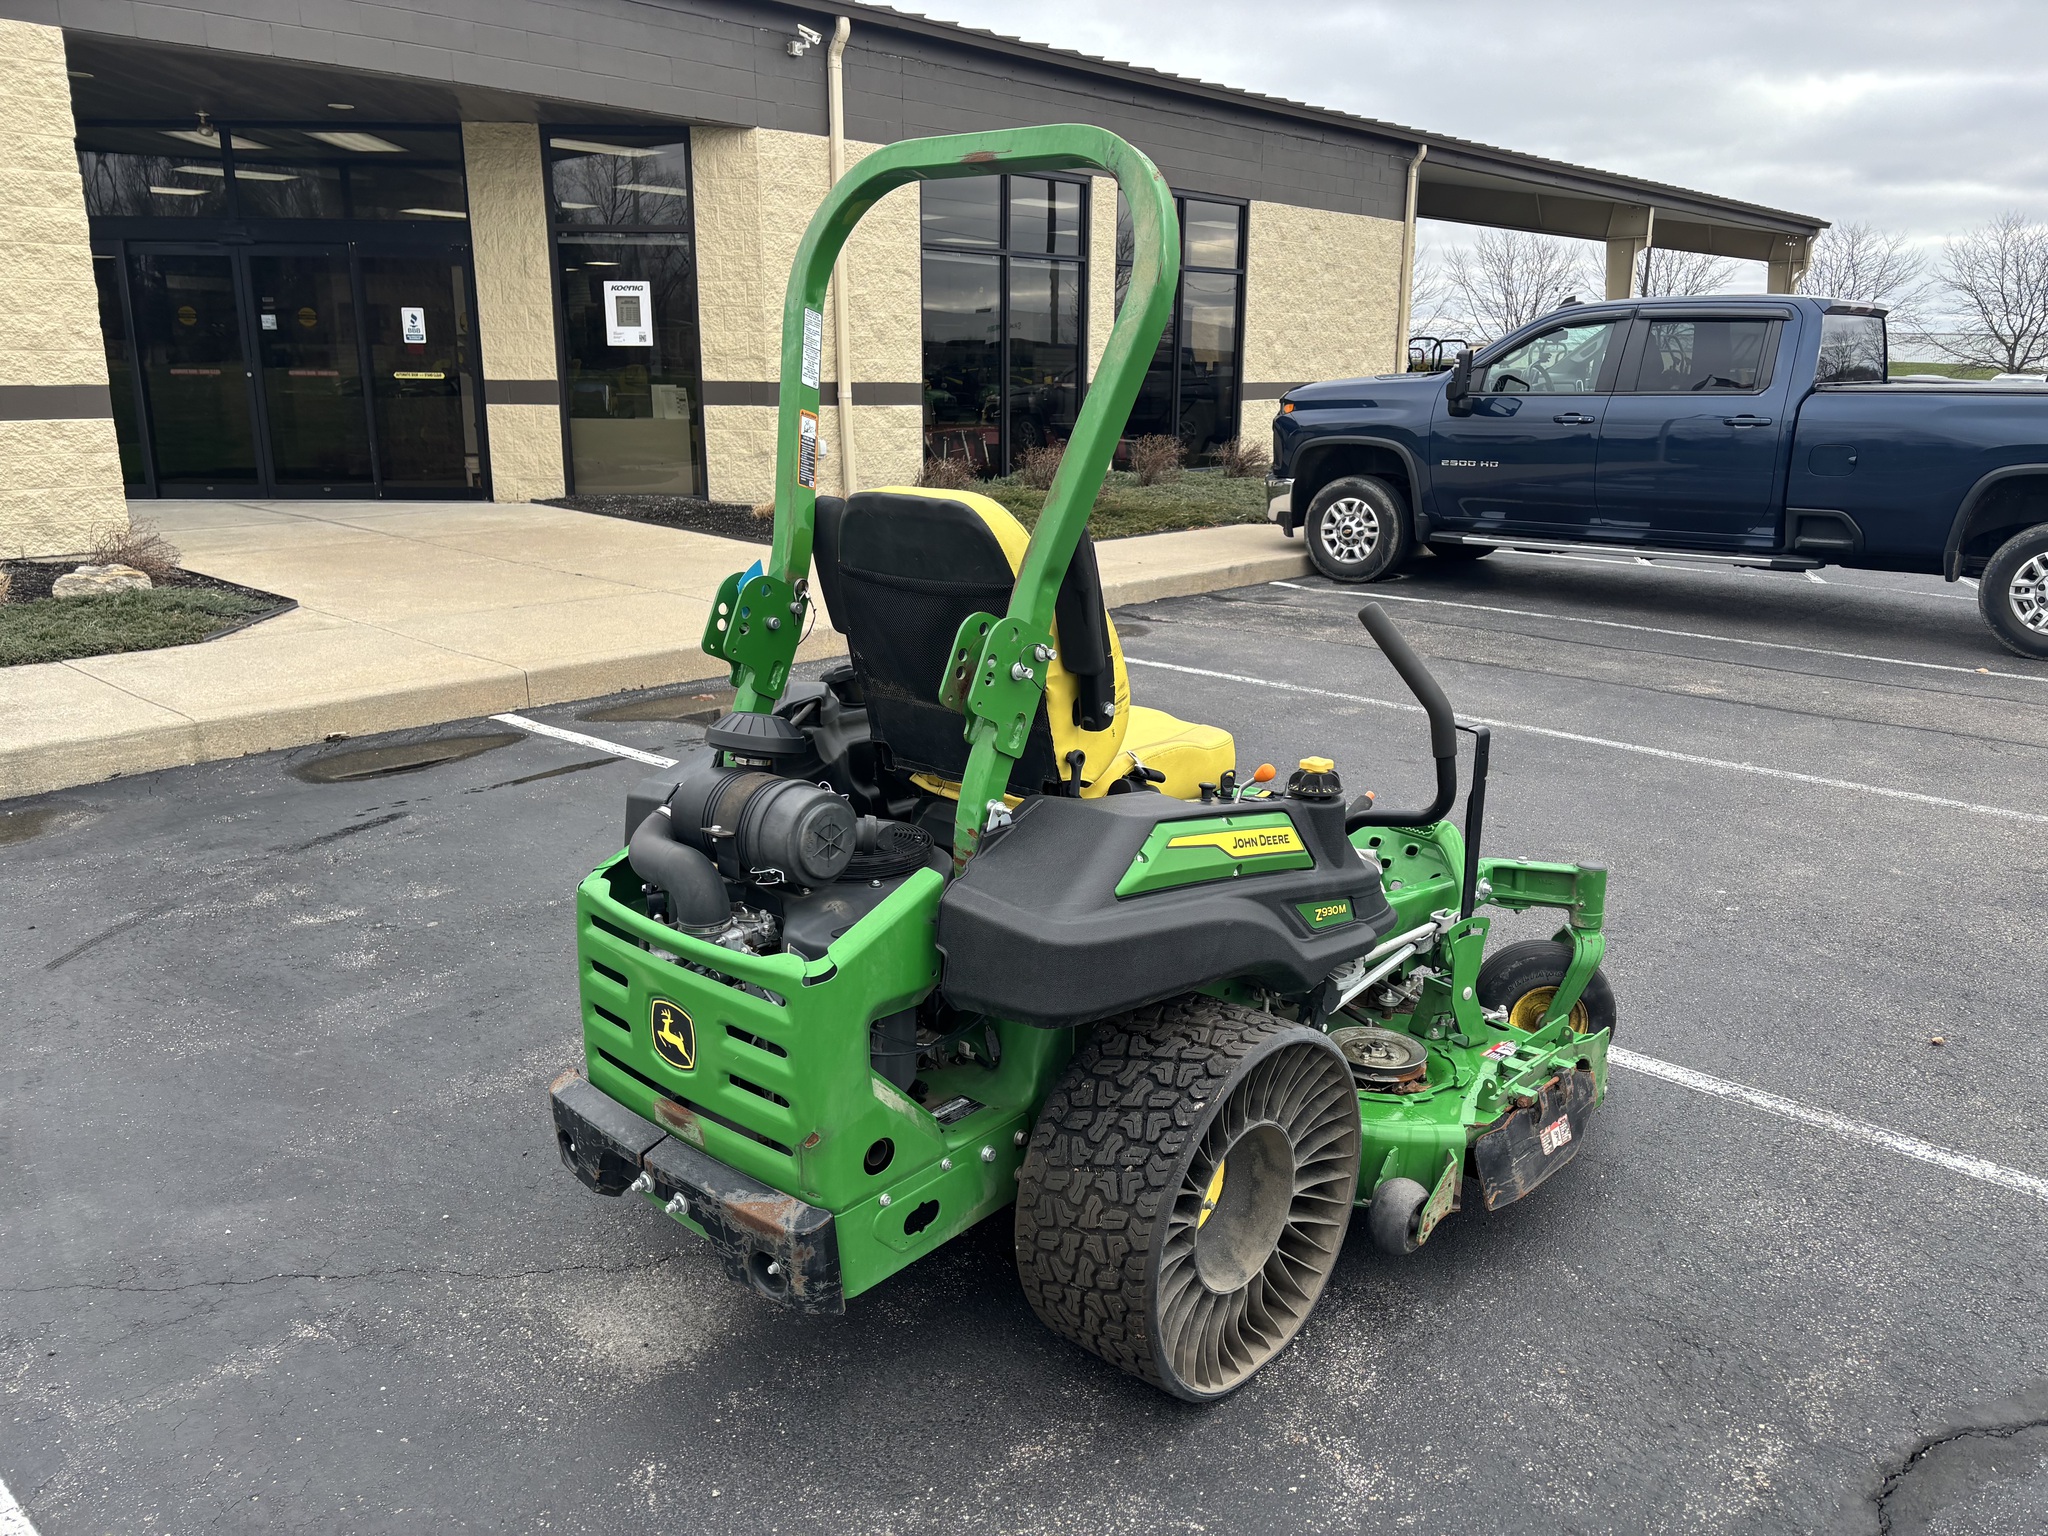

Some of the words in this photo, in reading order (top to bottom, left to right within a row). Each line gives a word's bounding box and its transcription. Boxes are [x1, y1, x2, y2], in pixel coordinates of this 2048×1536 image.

[1441, 459, 1477, 467] 2500
[1480, 460, 1499, 468] HD
[1232, 836, 1258, 849] JOHN
[1258, 834, 1290, 846] DEERE
[1314, 903, 1347, 922] Z930M
